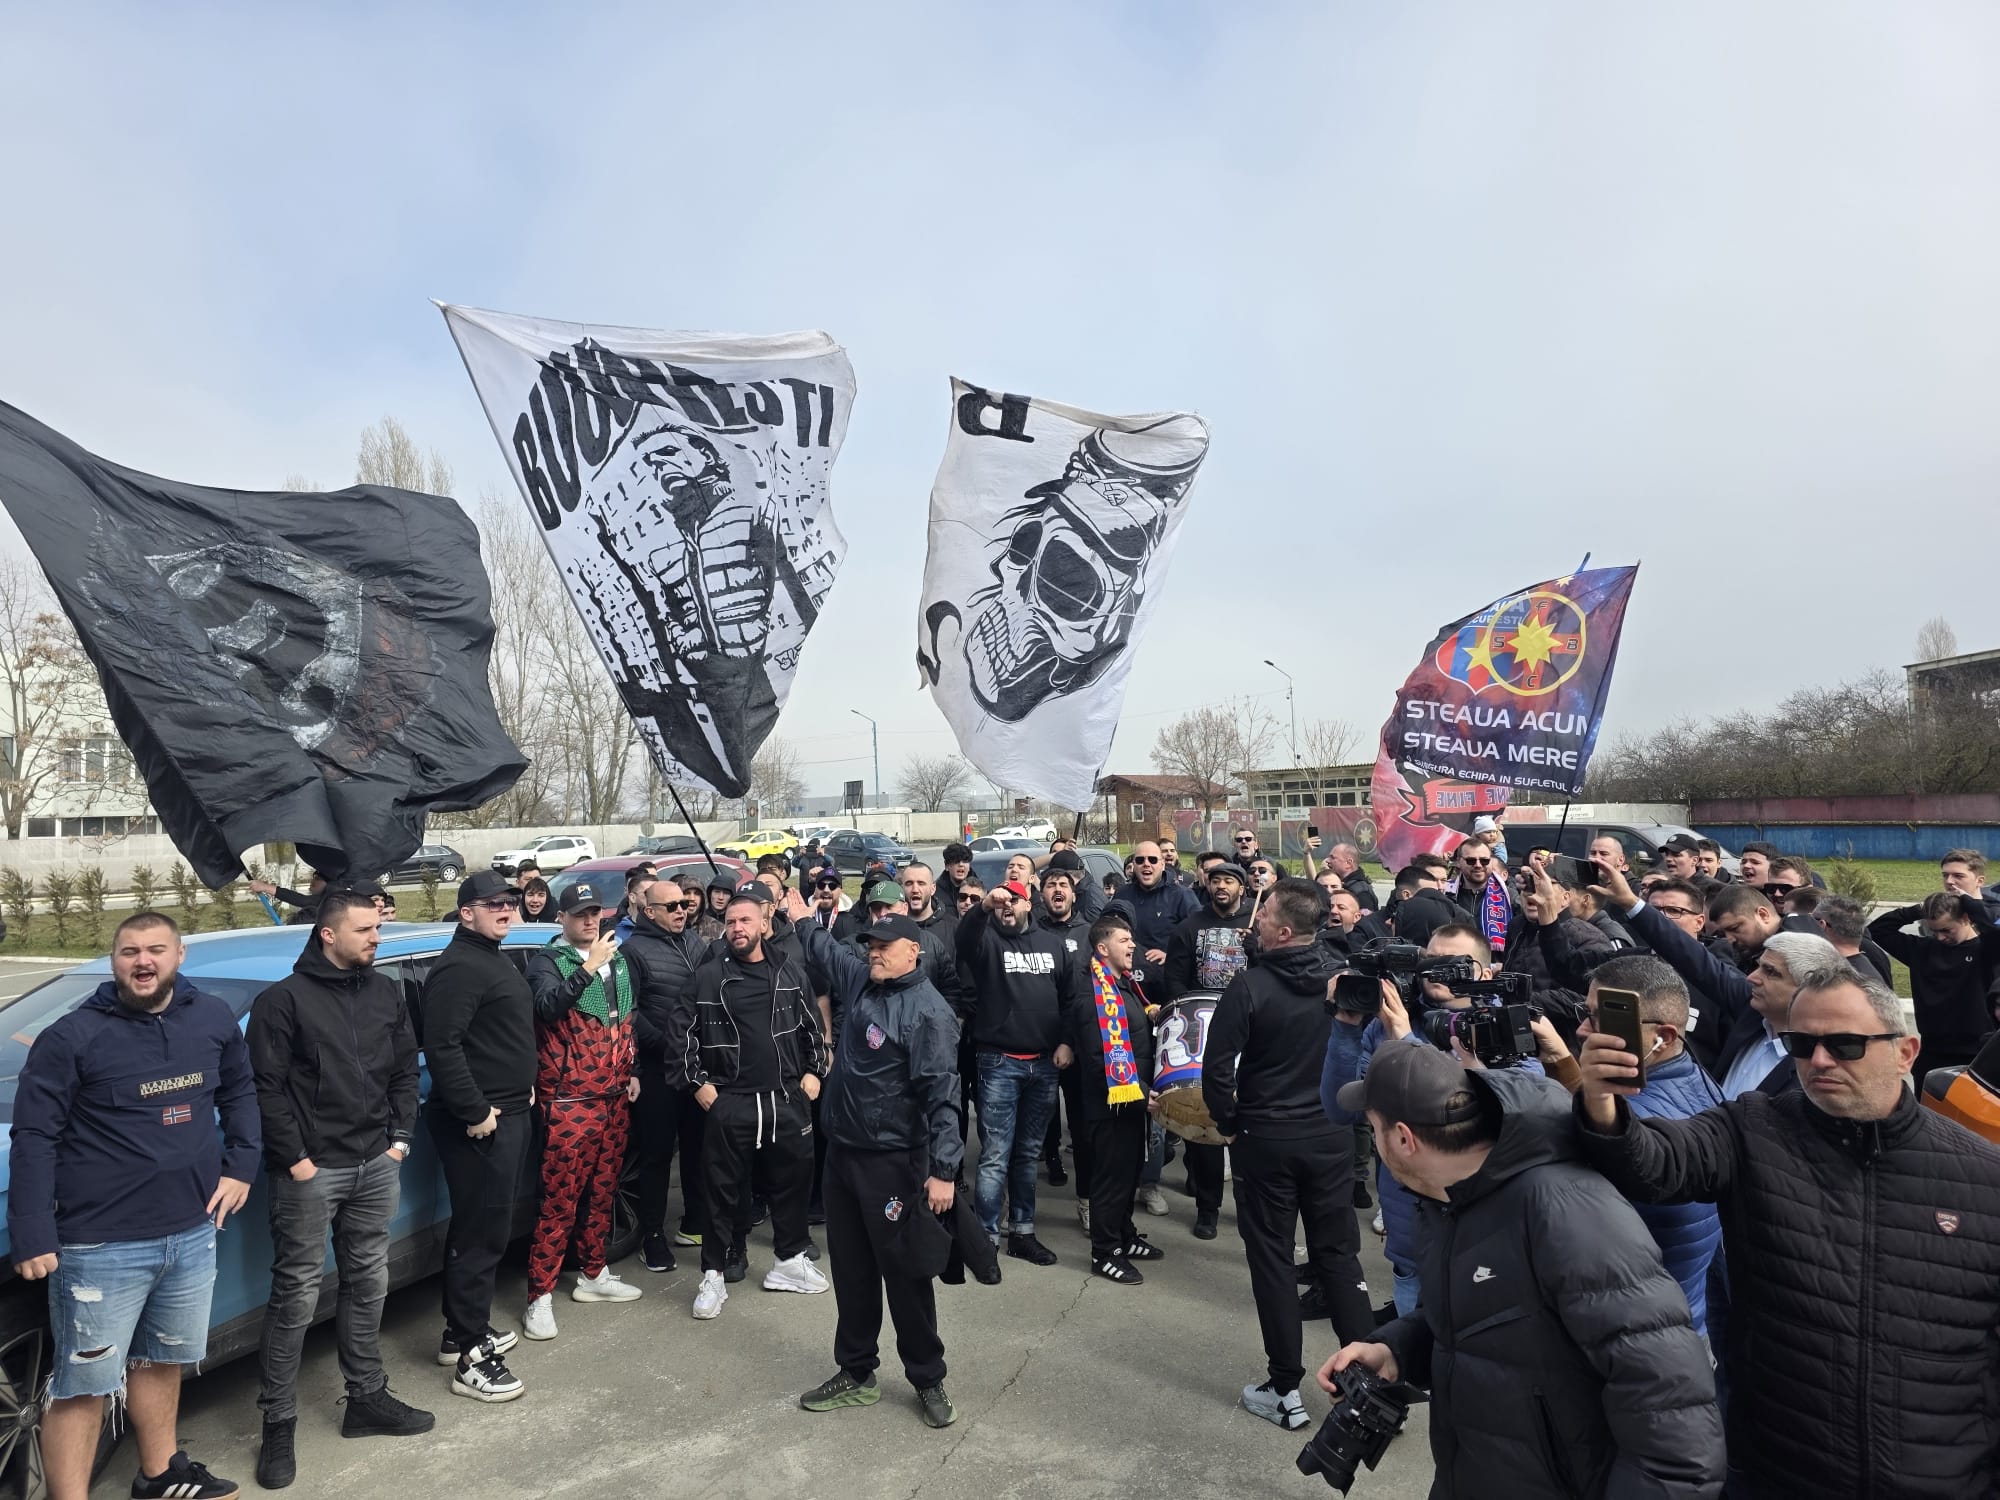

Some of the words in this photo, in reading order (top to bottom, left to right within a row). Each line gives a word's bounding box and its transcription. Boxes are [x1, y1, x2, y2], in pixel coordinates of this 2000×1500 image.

[1406, 699, 1511, 729] STEAUA
[1404, 731, 1500, 760] STEAUA
[1458, 769, 1496, 783] ECHIPA
[1499, 774, 1511, 785] IN
[1514, 776, 1568, 792] SUFLETUL
